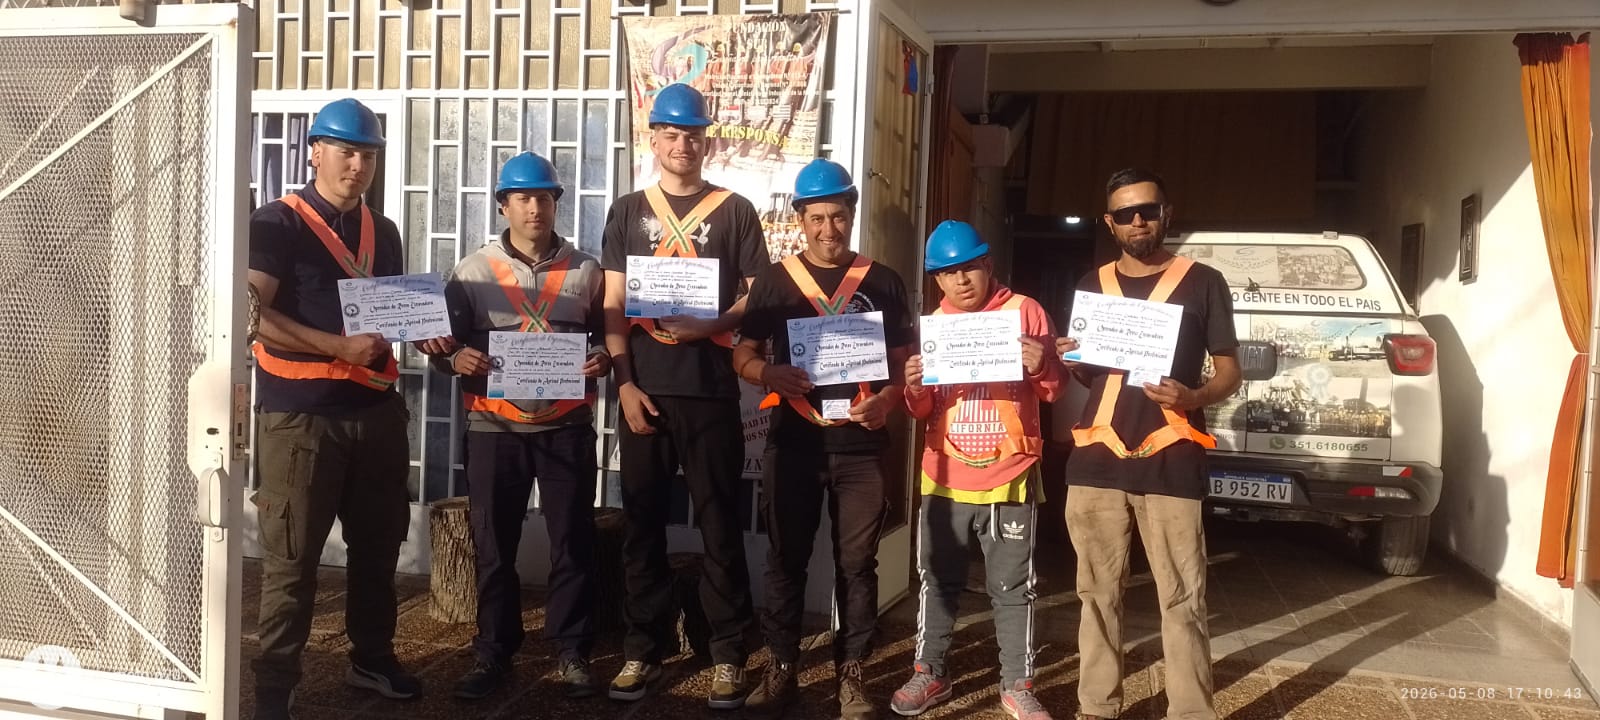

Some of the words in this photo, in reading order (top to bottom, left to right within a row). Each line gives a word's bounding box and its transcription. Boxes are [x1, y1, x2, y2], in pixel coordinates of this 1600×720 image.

[1242, 292, 1281, 304] GENTE
[1284, 293, 1300, 305] EN
[1302, 294, 1336, 307] TODO
[1338, 297, 1353, 308] EL
[1356, 298, 1382, 311] PAIS
[1288, 439, 1369, 452] 351.6180655
[1229, 480, 1260, 498] 952
[1266, 484, 1288, 500] RV
